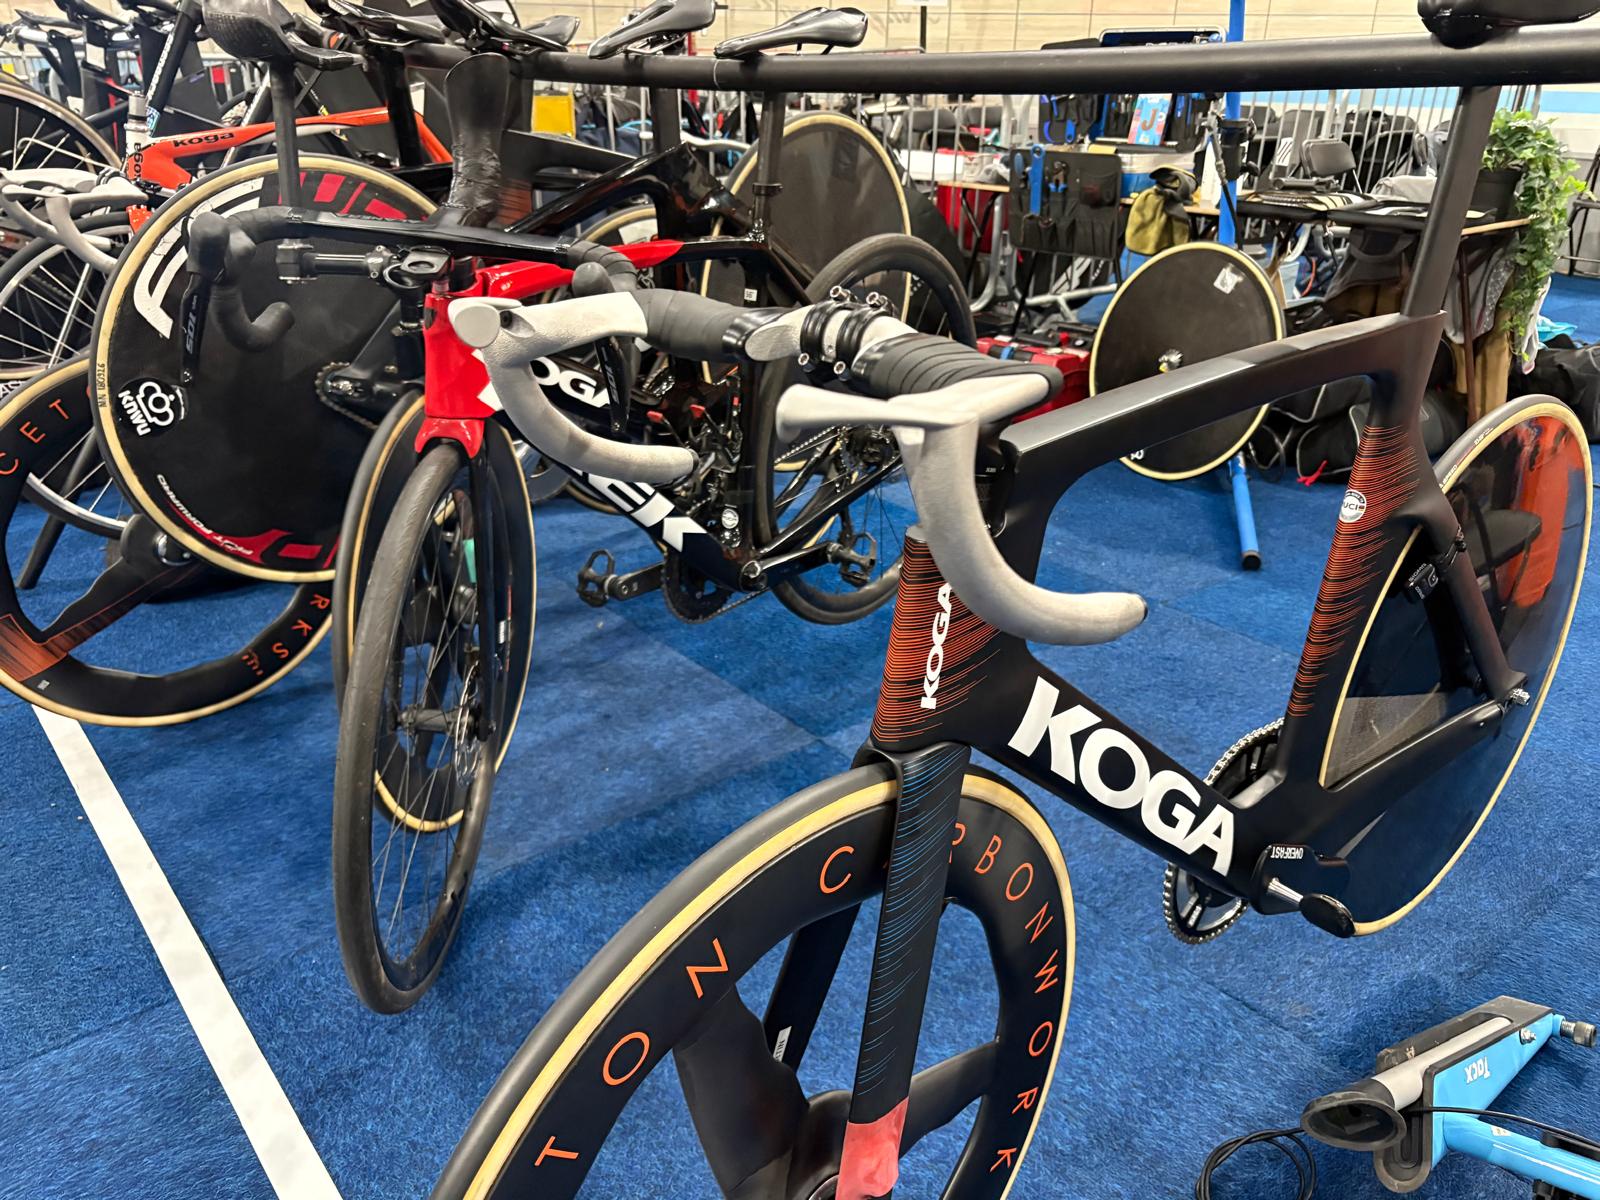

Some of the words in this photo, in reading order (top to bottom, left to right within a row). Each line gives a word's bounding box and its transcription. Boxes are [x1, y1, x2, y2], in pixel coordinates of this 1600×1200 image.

[173, 131, 235, 148] koga
[156, 473, 214, 535] FORWARD
[1343, 502, 1359, 511] UCI
[920, 581, 953, 710] KOGA
[1007, 675, 1235, 878] KOGA
[1270, 846, 1304, 860] OVERFAST
[1463, 1055, 1491, 1084] Tacx
